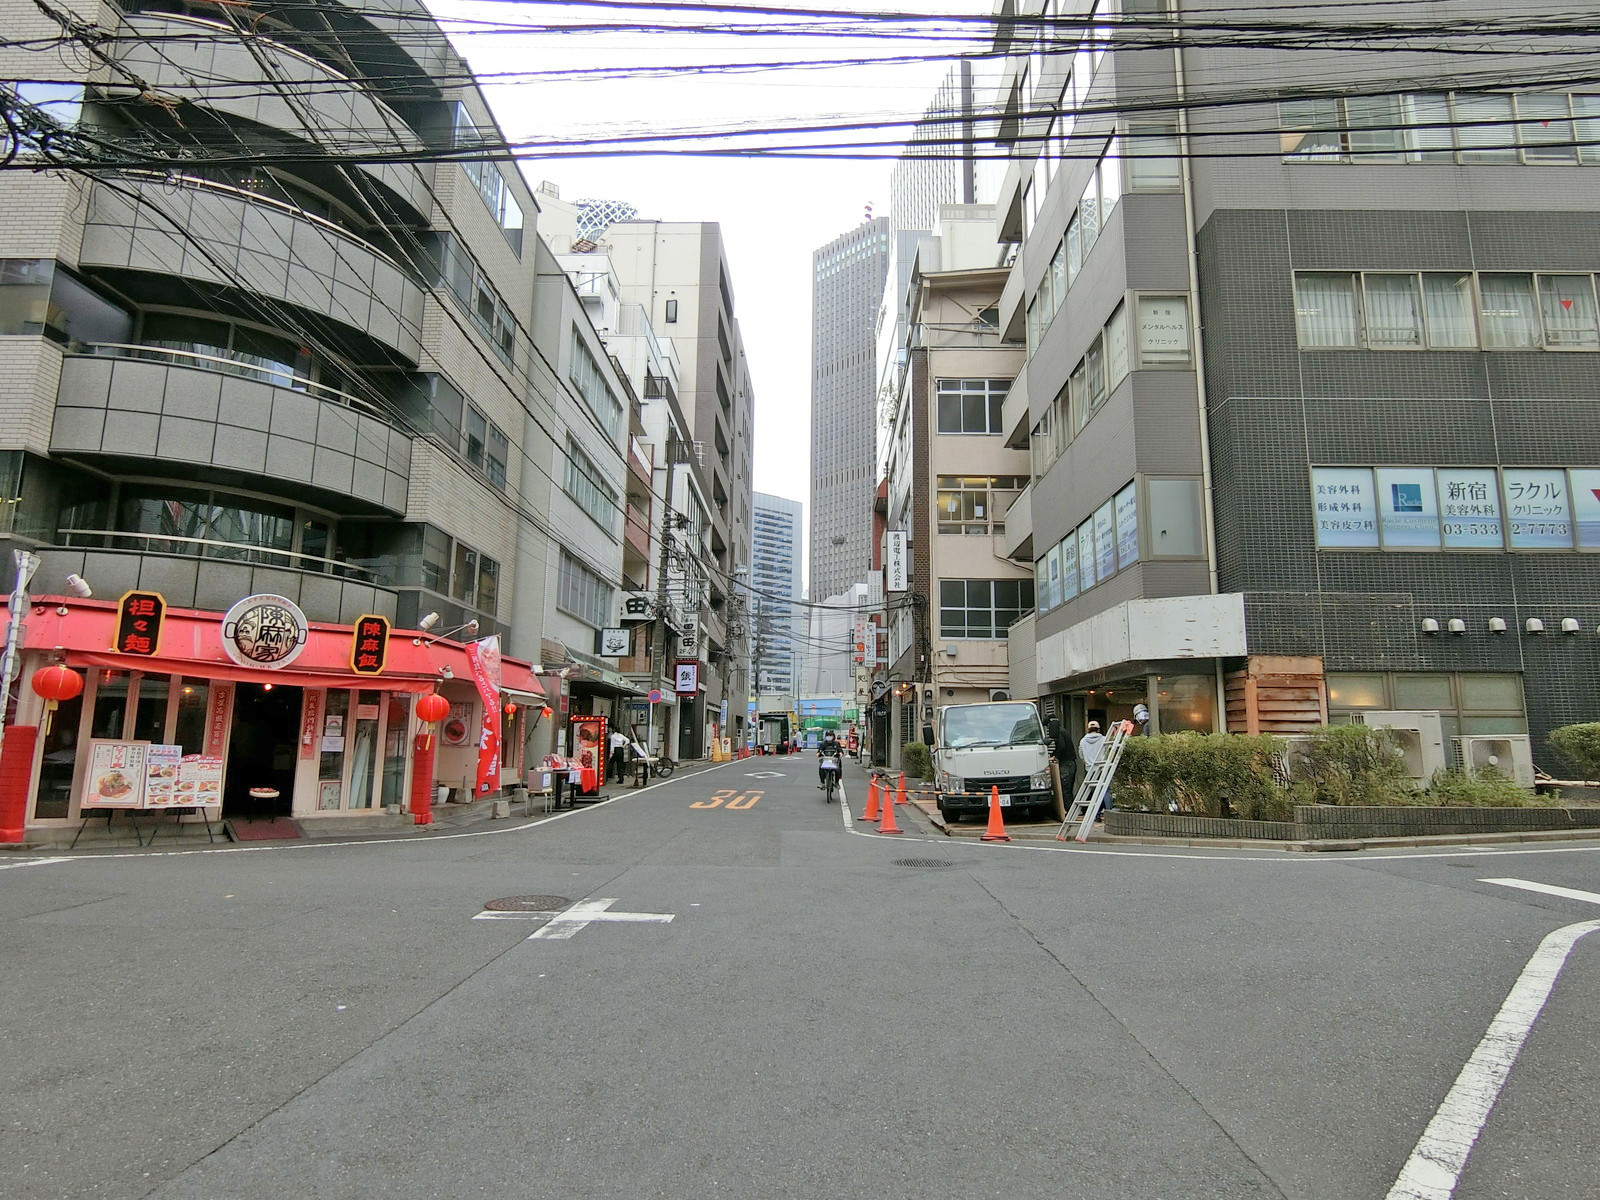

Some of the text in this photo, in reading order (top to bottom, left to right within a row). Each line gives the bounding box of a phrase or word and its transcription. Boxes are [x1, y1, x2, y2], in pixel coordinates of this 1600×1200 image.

[1317, 485, 1361, 494] 美容外科
[1446, 481, 1562, 501] 新宿 ラクル
[1317, 502, 1362, 512] 形成外科
[1444, 504, 1563, 517] 美容外科 クリニック
[1320, 520, 1373, 530] 美容皮フ科
[1443, 523, 1568, 536] 03-533 2-7773
[124, 599, 155, 653] 担々麺
[254, 606, 286, 661] 陳麻家
[358, 622, 382, 667] 陳麻飯
[689, 789, 766, 810] 30
